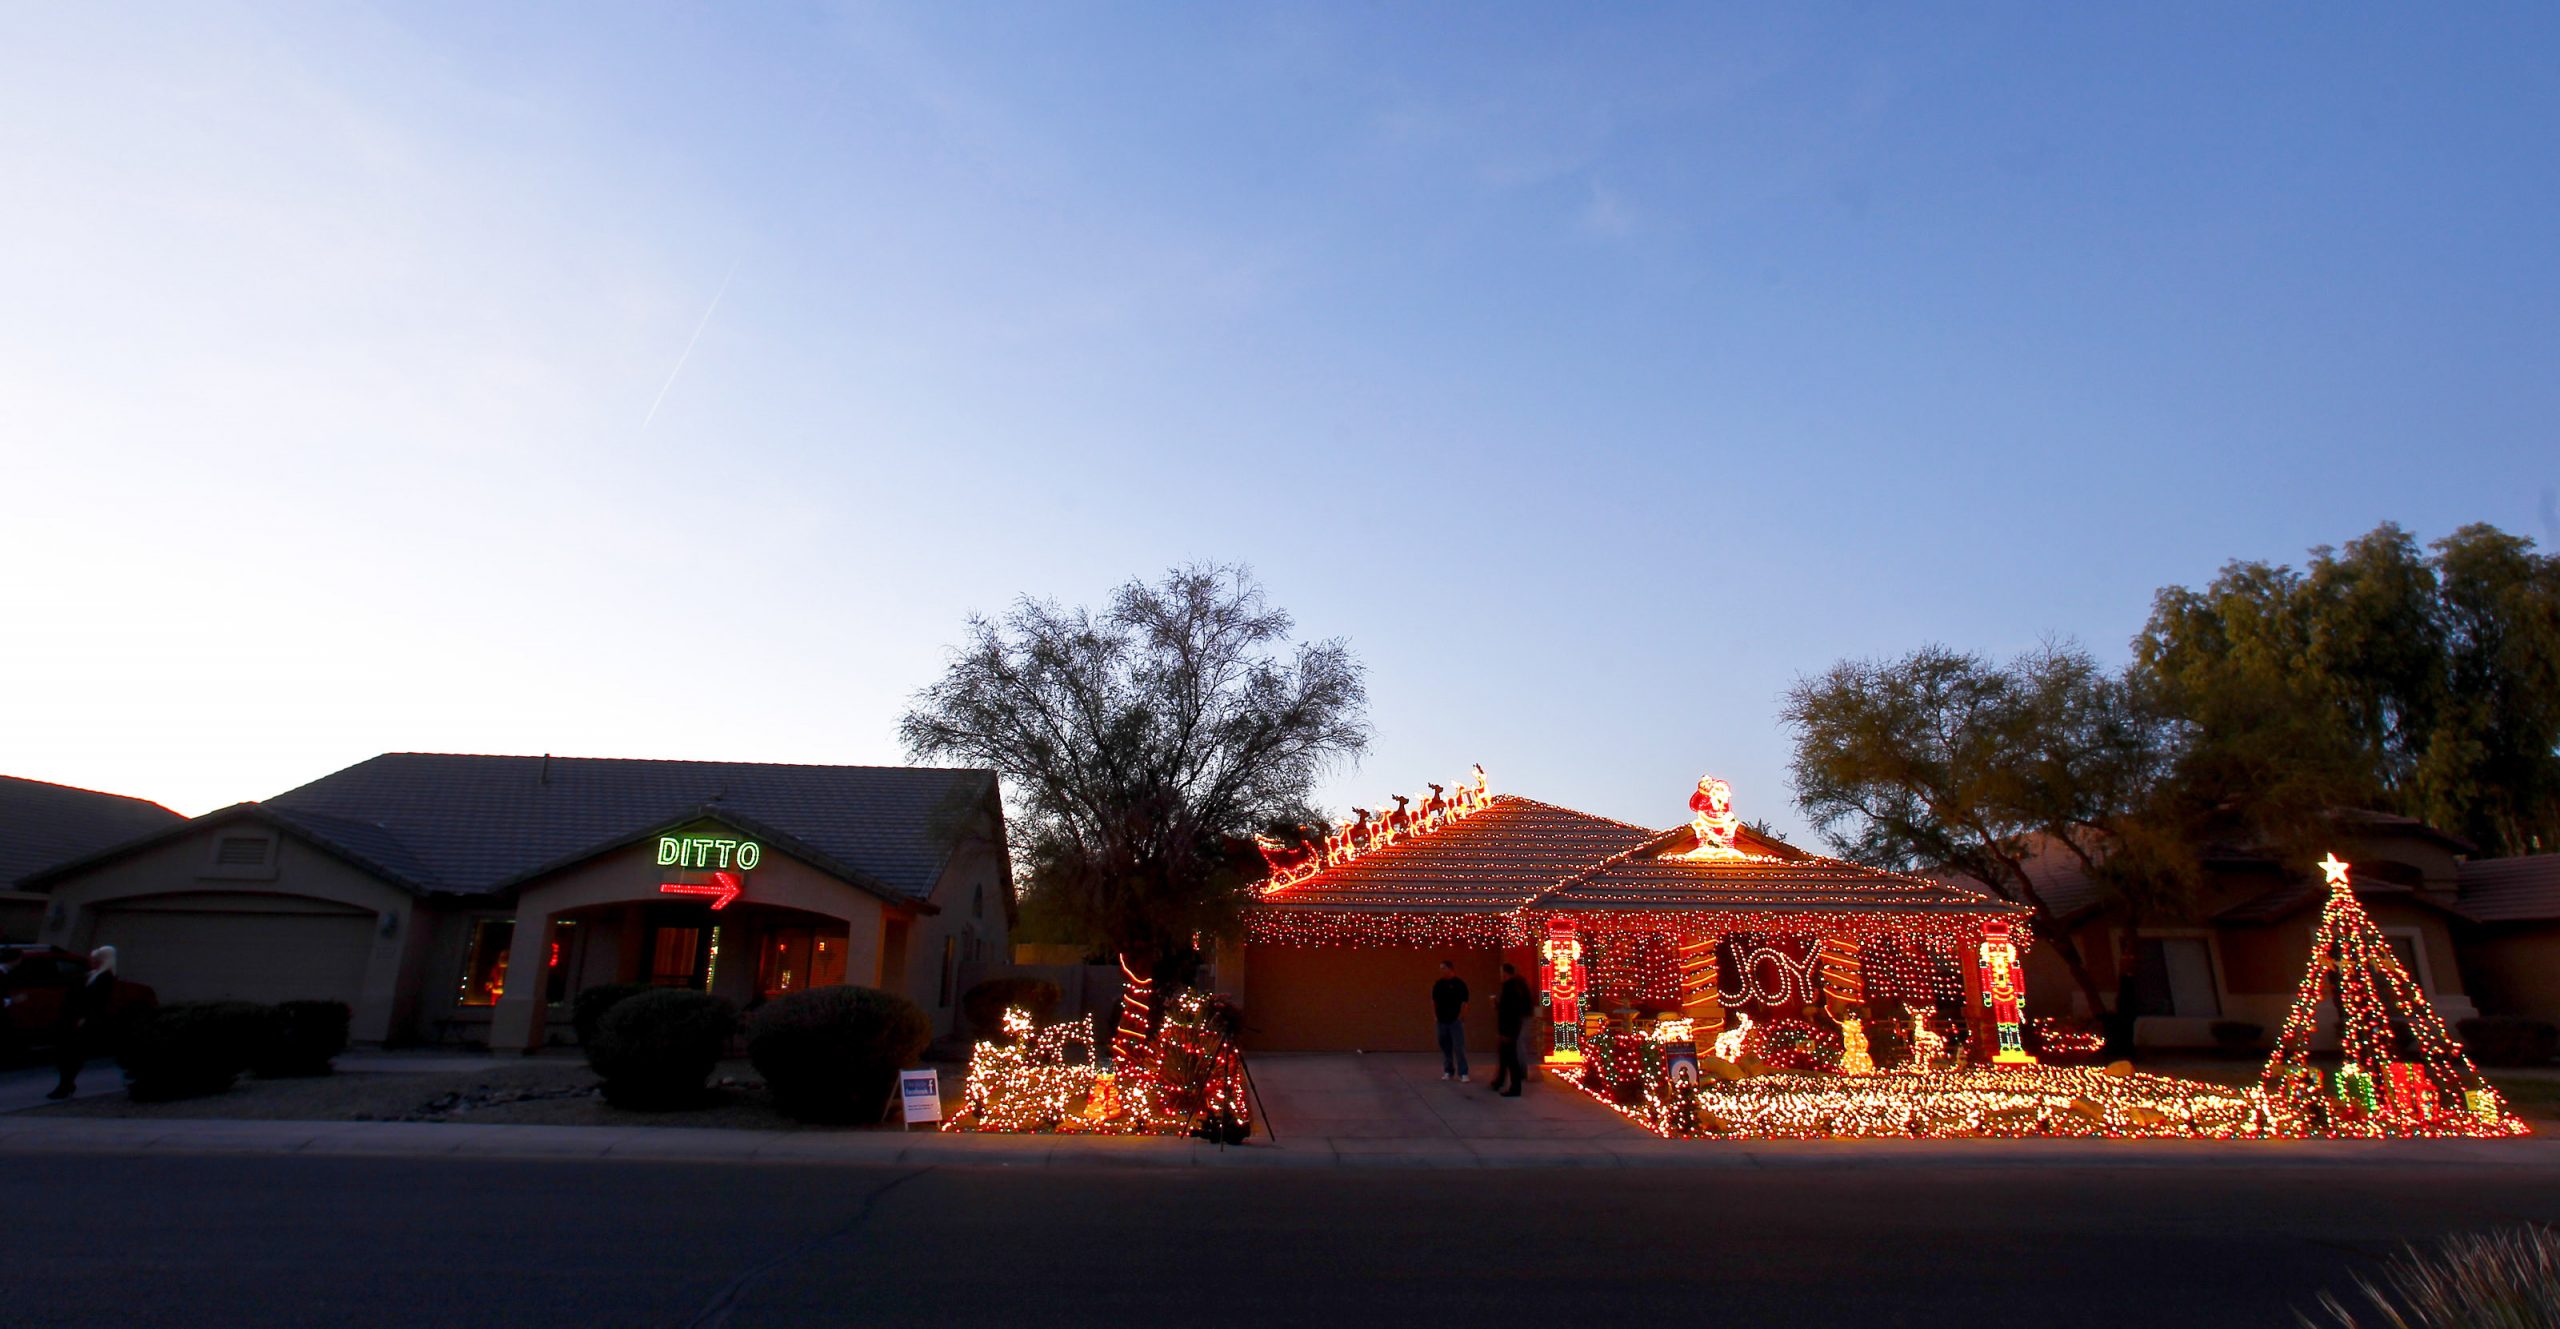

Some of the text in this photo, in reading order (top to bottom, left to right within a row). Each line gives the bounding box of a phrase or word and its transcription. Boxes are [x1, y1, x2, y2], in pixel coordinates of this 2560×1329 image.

[657, 837, 760, 870] DITTO
[1717, 939, 1824, 1007] JOY
[928, 1079, 934, 1094] f
